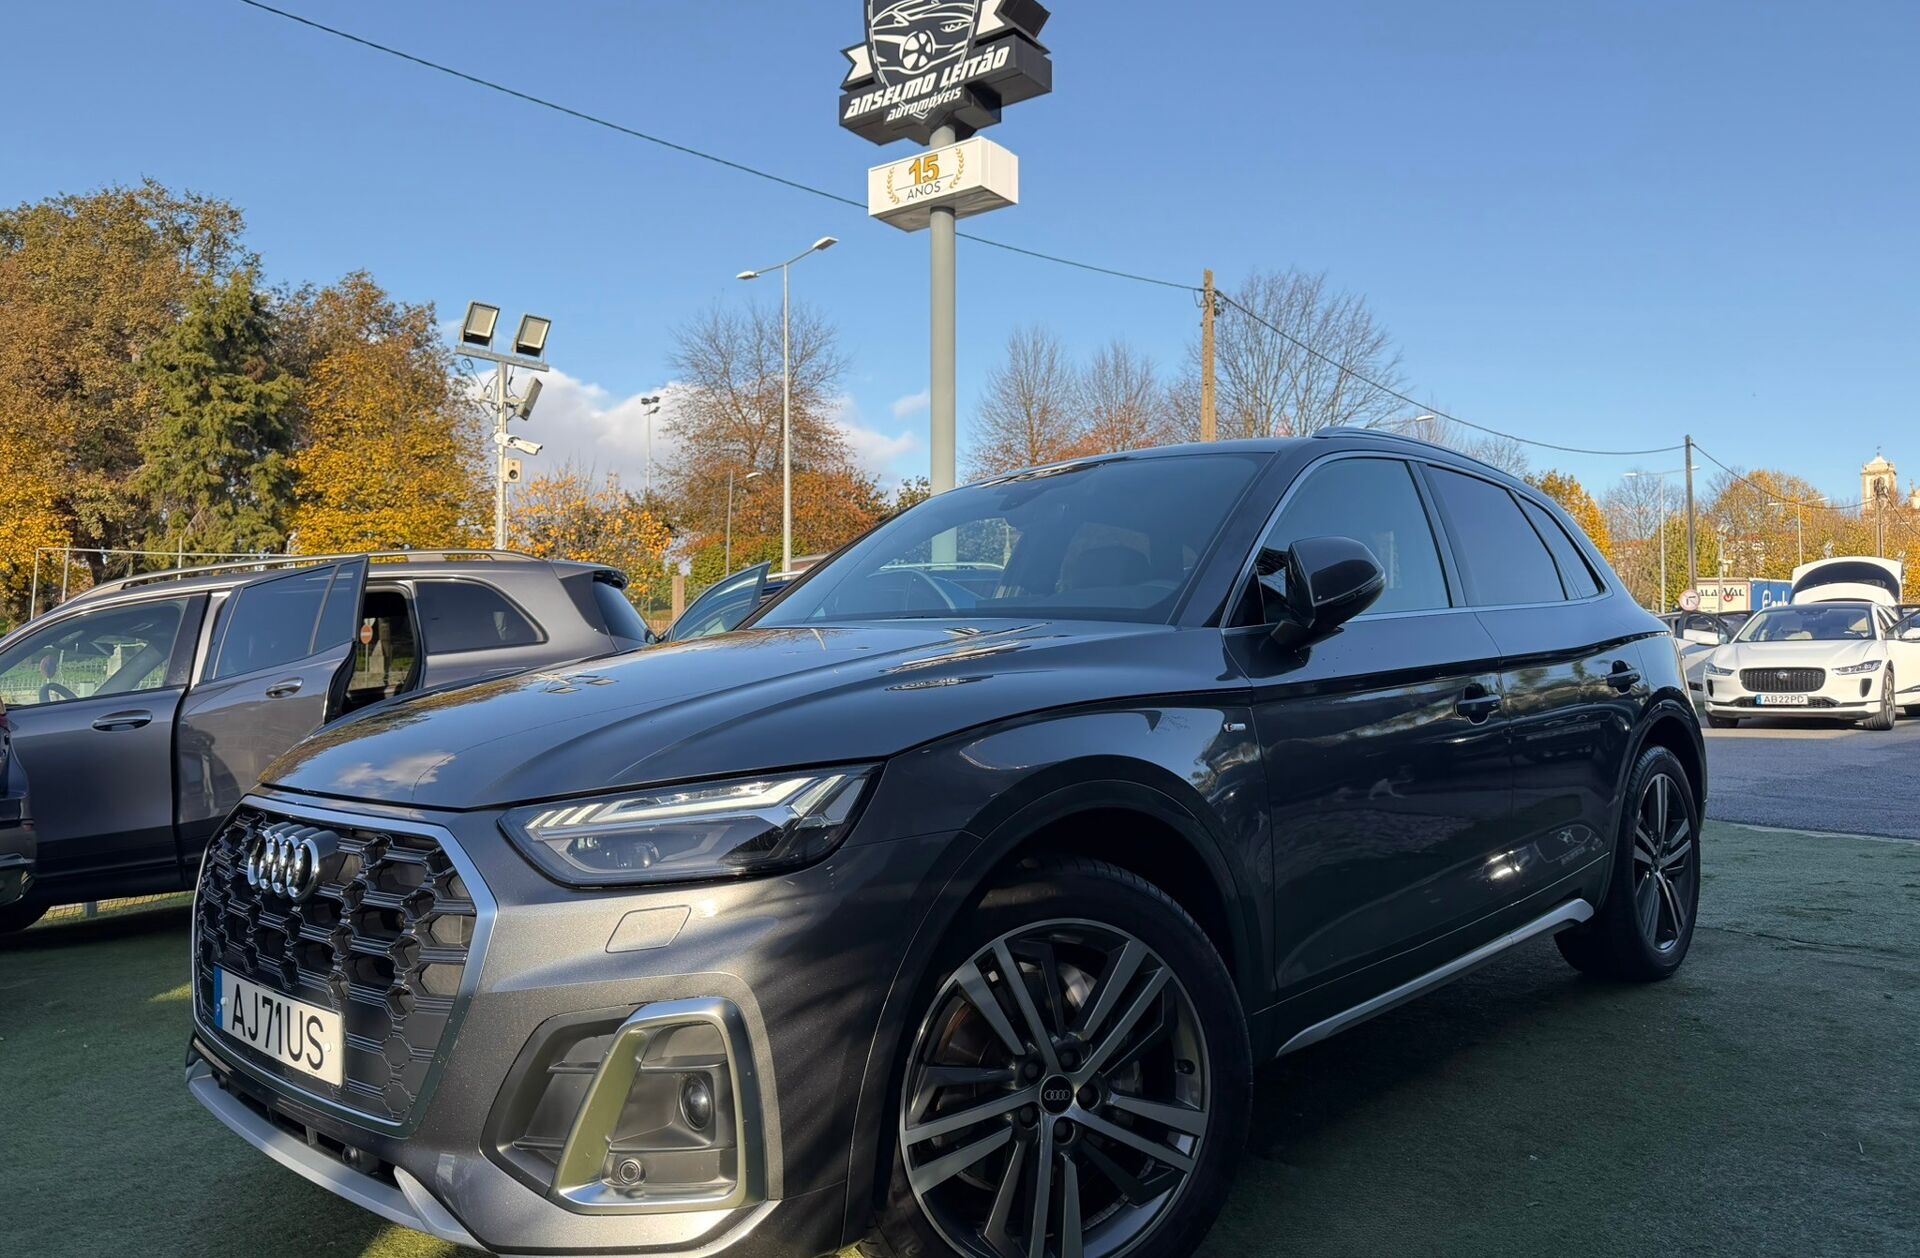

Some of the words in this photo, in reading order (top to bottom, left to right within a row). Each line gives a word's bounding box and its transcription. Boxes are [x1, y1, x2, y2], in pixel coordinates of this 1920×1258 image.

[908, 153, 940, 186] 15
[906, 180, 941, 200] ANOS
[231, 983, 324, 1071] AJ71US
